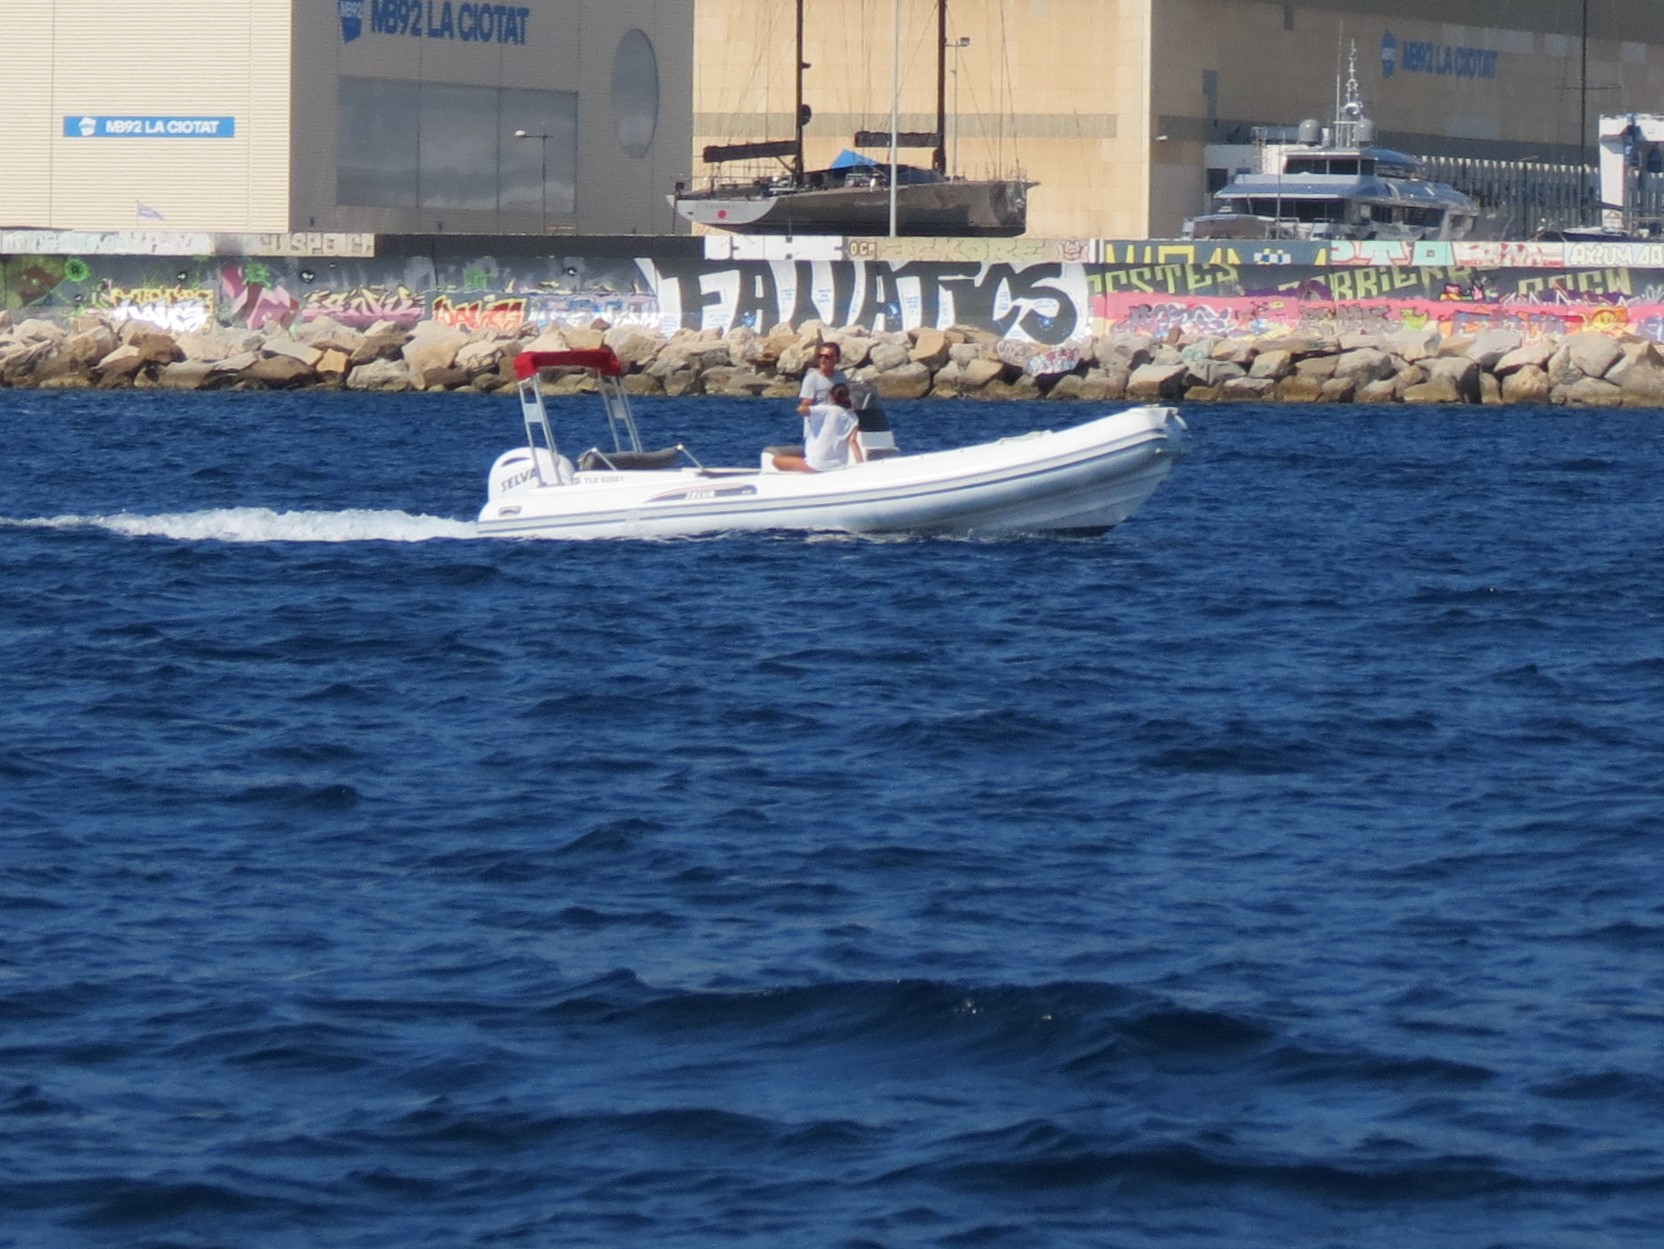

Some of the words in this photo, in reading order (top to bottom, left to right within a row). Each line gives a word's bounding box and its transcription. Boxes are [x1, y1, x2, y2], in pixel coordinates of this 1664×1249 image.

[427, 0, 454, 39] LA
[458, 2, 530, 44] CIOTAT
[105, 120, 142, 133] MB92
[145, 120, 163, 133] LA
[167, 120, 219, 133] CIOTAT
[500, 468, 537, 492] SELVA
